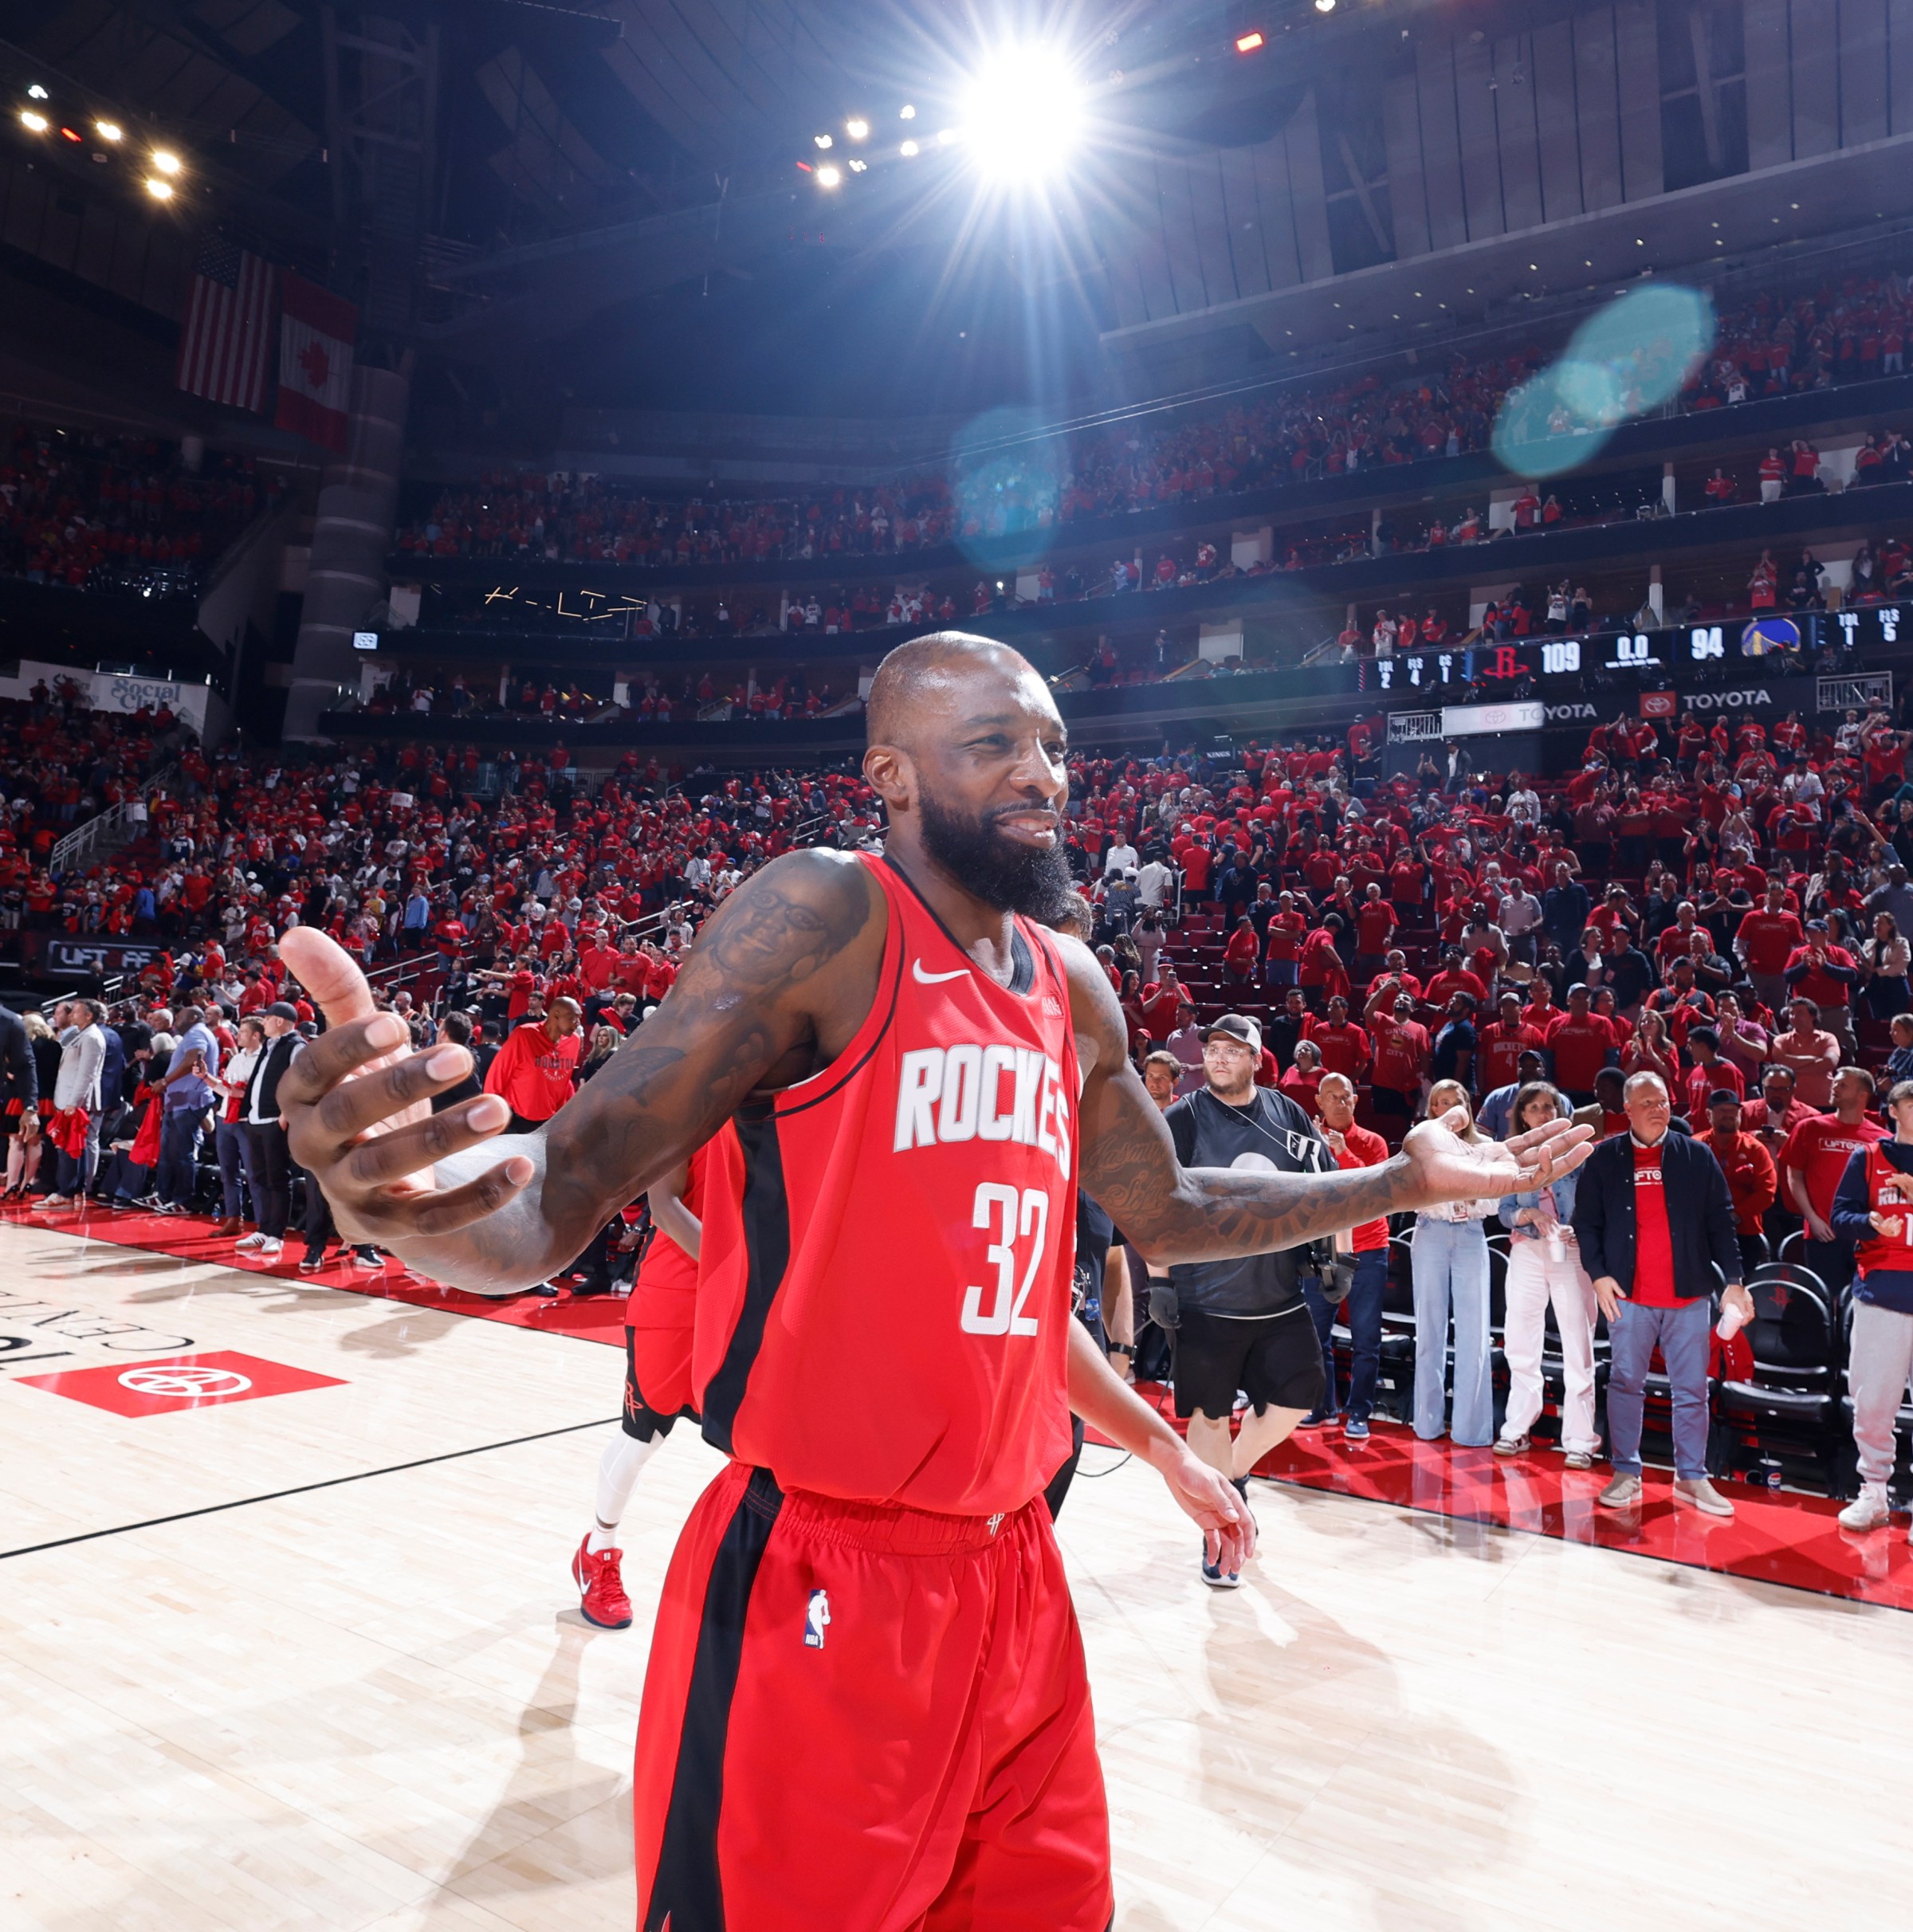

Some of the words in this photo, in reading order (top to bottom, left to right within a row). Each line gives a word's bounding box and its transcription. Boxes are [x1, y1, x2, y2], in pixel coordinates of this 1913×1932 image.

[1879, 608, 1899, 622] FLS
[1691, 626, 1724, 660] 94
[1844, 626, 1853, 646] 1
[1884, 622, 1896, 642] 5
[1542, 642, 1580, 673] 109
[1617, 634, 1648, 660] 0.0
[1381, 672, 1391, 689] 2
[1410, 670, 1420, 686] 4
[1442, 666, 1449, 683] 1
[111, 678, 181, 703] Social
[1683, 689, 1771, 709] TOYOTA
[1518, 703, 1597, 722] TOYOTA
[1386, 1048, 1404, 1058] CITY
[1506, 1053, 1513, 1067] 4
[960, 1181, 1048, 1337] 32
[805, 1633, 819, 1646] NBA
